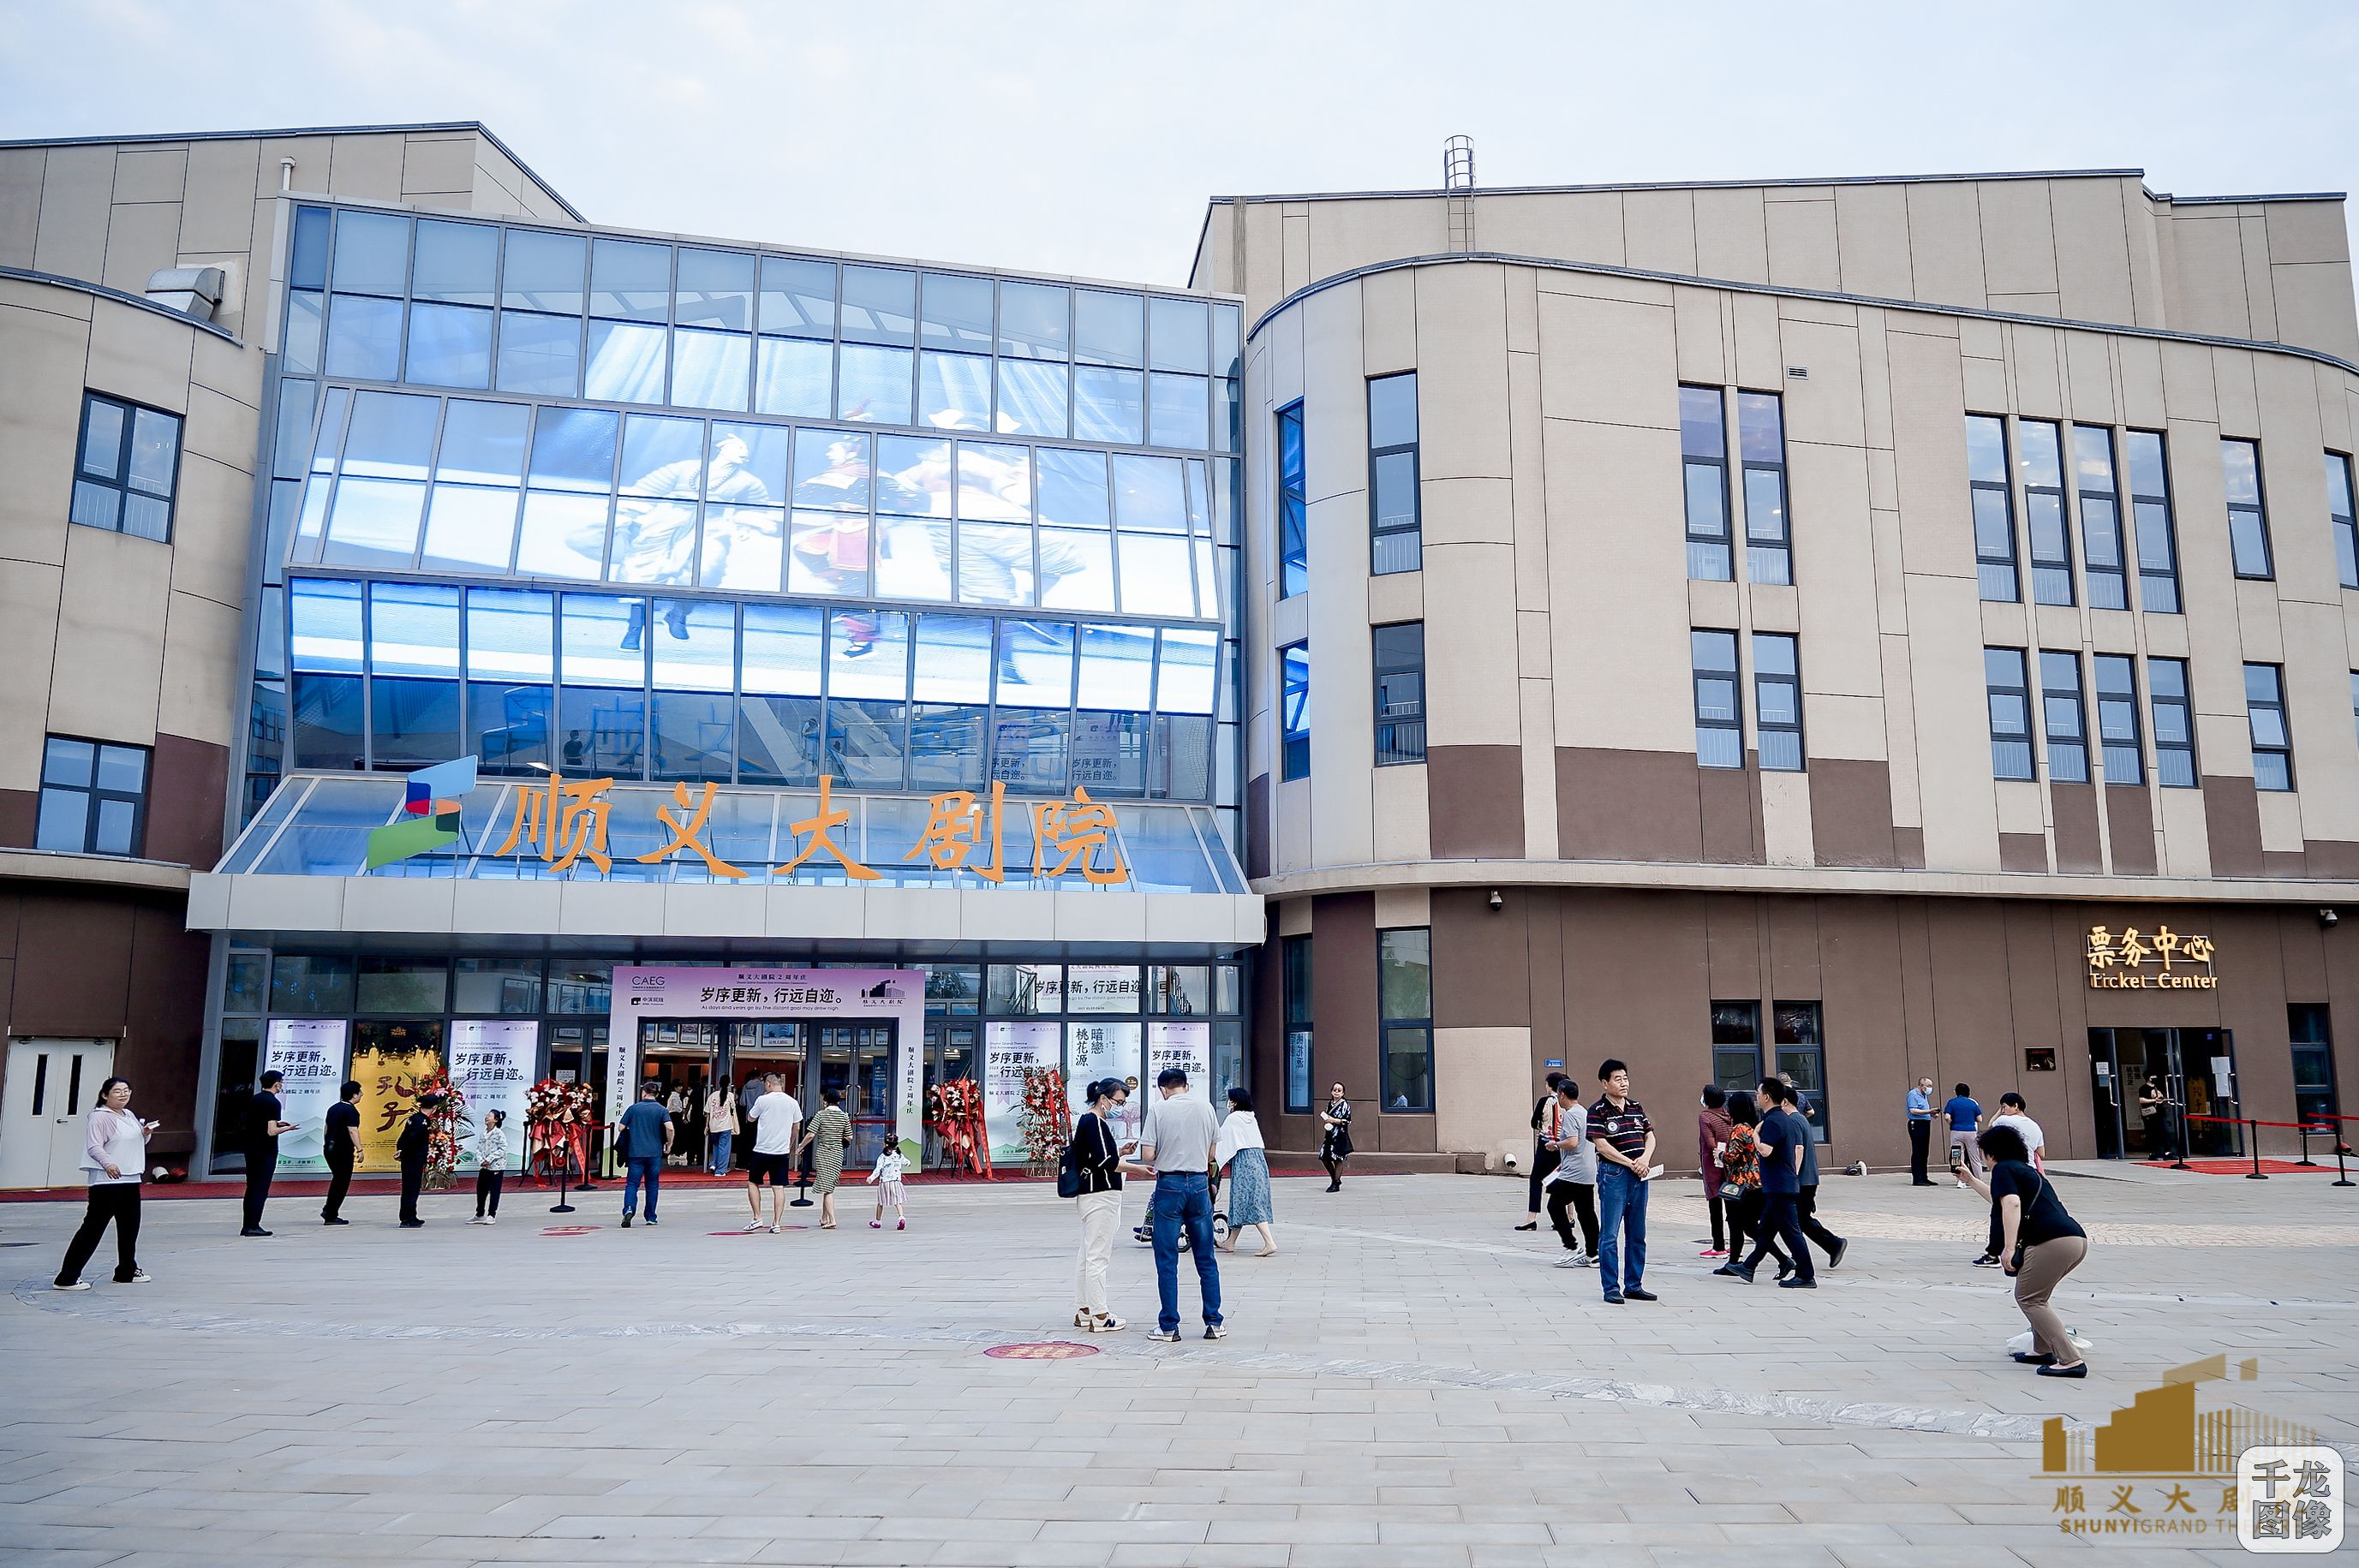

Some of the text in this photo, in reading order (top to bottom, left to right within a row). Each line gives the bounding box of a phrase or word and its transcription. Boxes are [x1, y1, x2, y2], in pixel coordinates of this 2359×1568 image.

[1072, 758, 1117, 769] 岁序更新，
[494, 774, 1128, 885] 顺义大剧院
[2087, 926, 2215, 970] 票务中心
[631, 975, 665, 986] CAEG
[2090, 972, 2218, 989] Ticket Center
[700, 987, 842, 1004] 岁序更新，行远自迩。
[1075, 1028, 1089, 1067] 桃花源
[1091, 1028, 1104, 1054] 暗戀
[271, 1050, 326, 1063] 岁序更新，
[455, 1052, 512, 1065] 岁序更新，
[989, 1052, 1040, 1064] 岁序更新，
[1152, 1050, 1197, 1061] 岁序更新，
[282, 1064, 337, 1076] 行远自迩。
[466, 1068, 524, 1081] 行远自迩。
